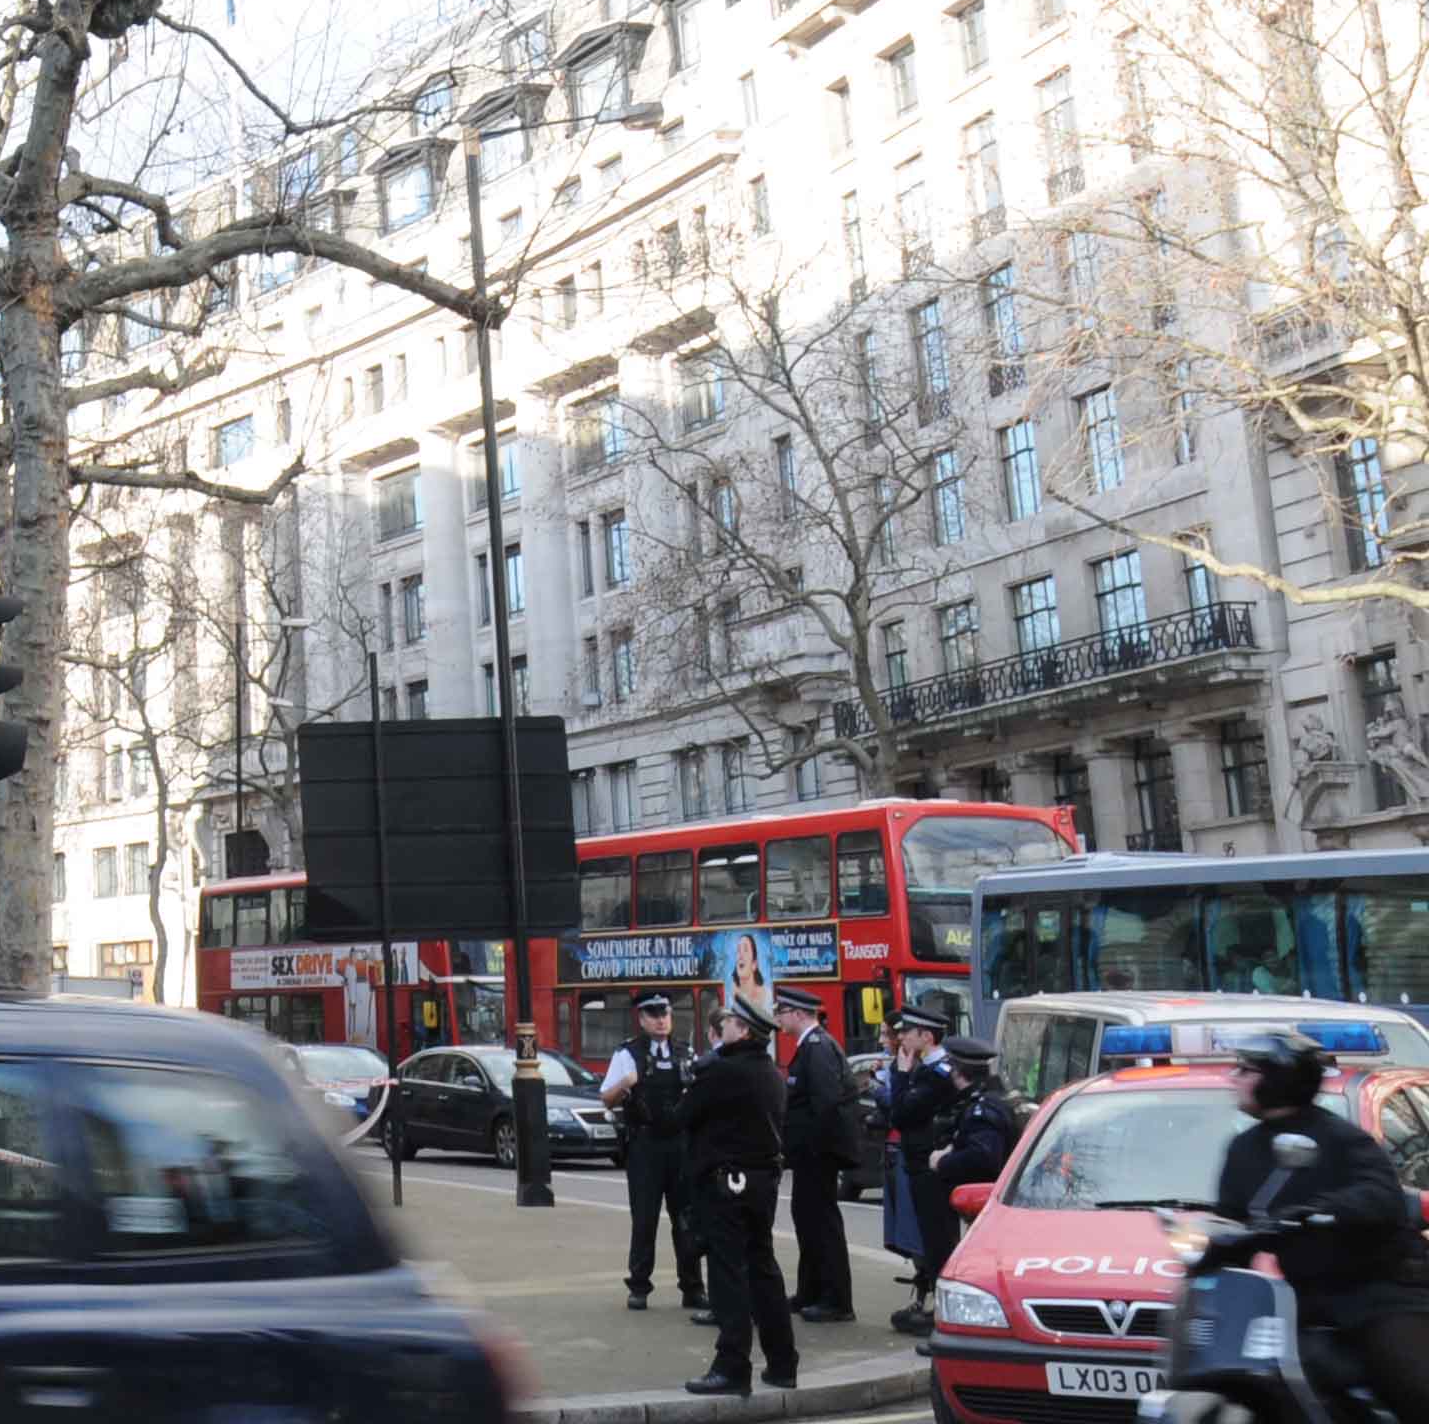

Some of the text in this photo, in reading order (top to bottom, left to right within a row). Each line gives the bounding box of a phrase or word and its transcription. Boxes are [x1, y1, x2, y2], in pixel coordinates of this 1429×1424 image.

[654, 937, 667, 956] IN
[670, 936, 693, 955] THE
[271, 955, 294, 977] SEX
[296, 952, 333, 975] DRIVE
[581, 961, 621, 979] CROWD
[1014, 1255, 1188, 1277] POLIC
[1059, 1367, 1128, 1394] LX03
